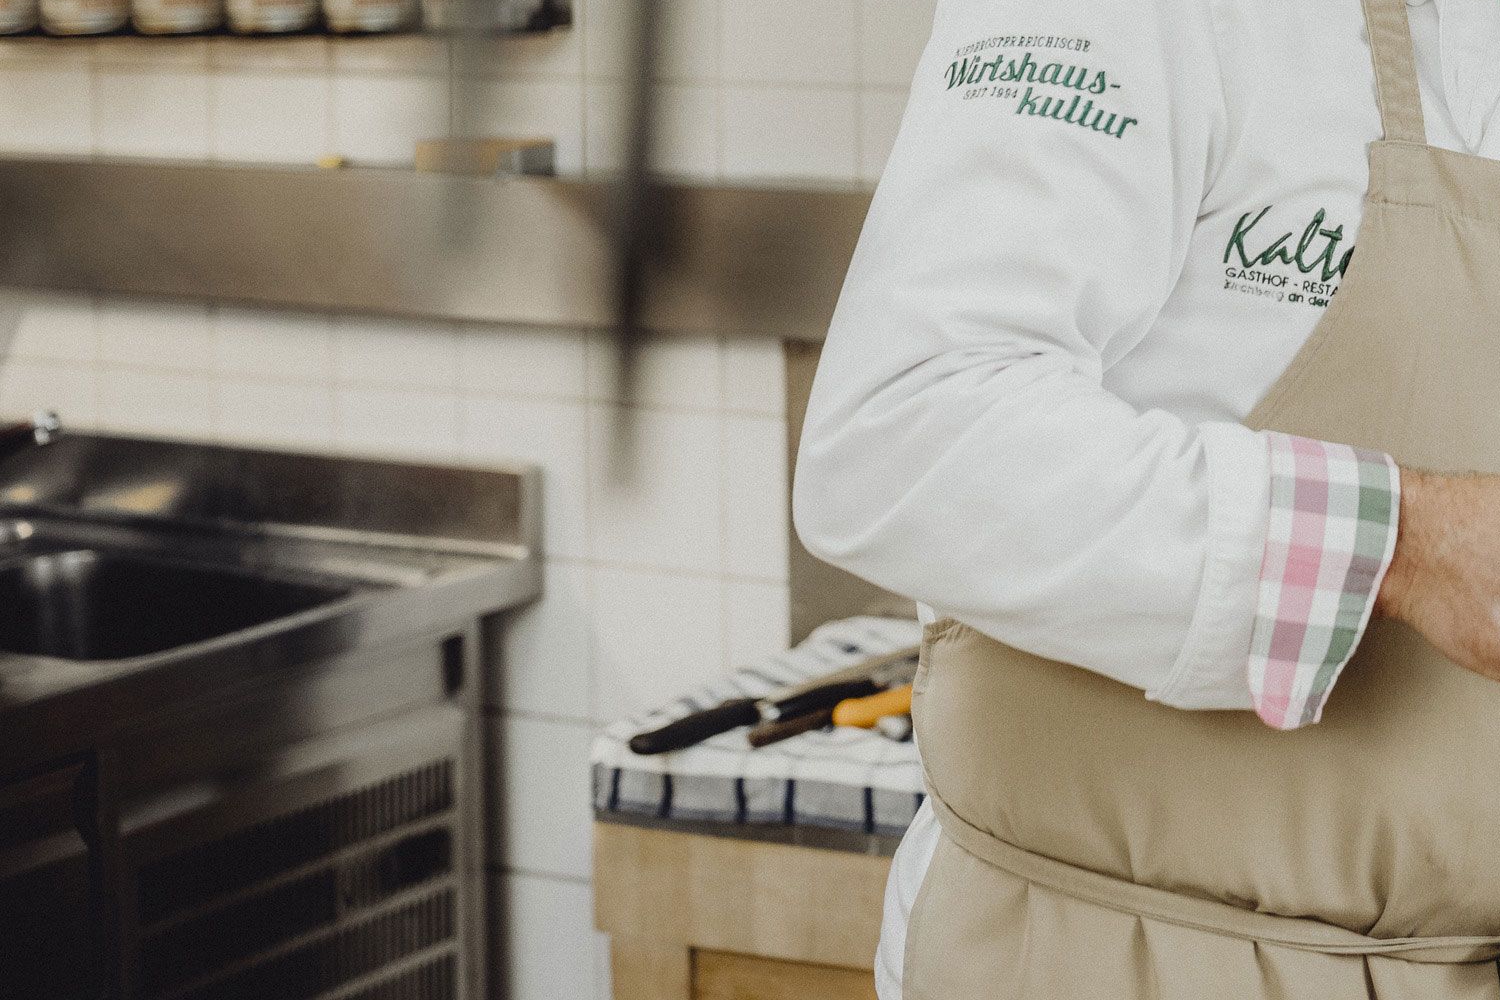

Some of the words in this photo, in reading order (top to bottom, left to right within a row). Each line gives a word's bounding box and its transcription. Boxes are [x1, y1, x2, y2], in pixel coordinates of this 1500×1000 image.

[944, 52, 1121, 95] Wirtshaus-
[1016, 87, 1138, 139] kultur
[1225, 267, 1290, 288] GASTHOF
[1288, 293, 1304, 303] an
